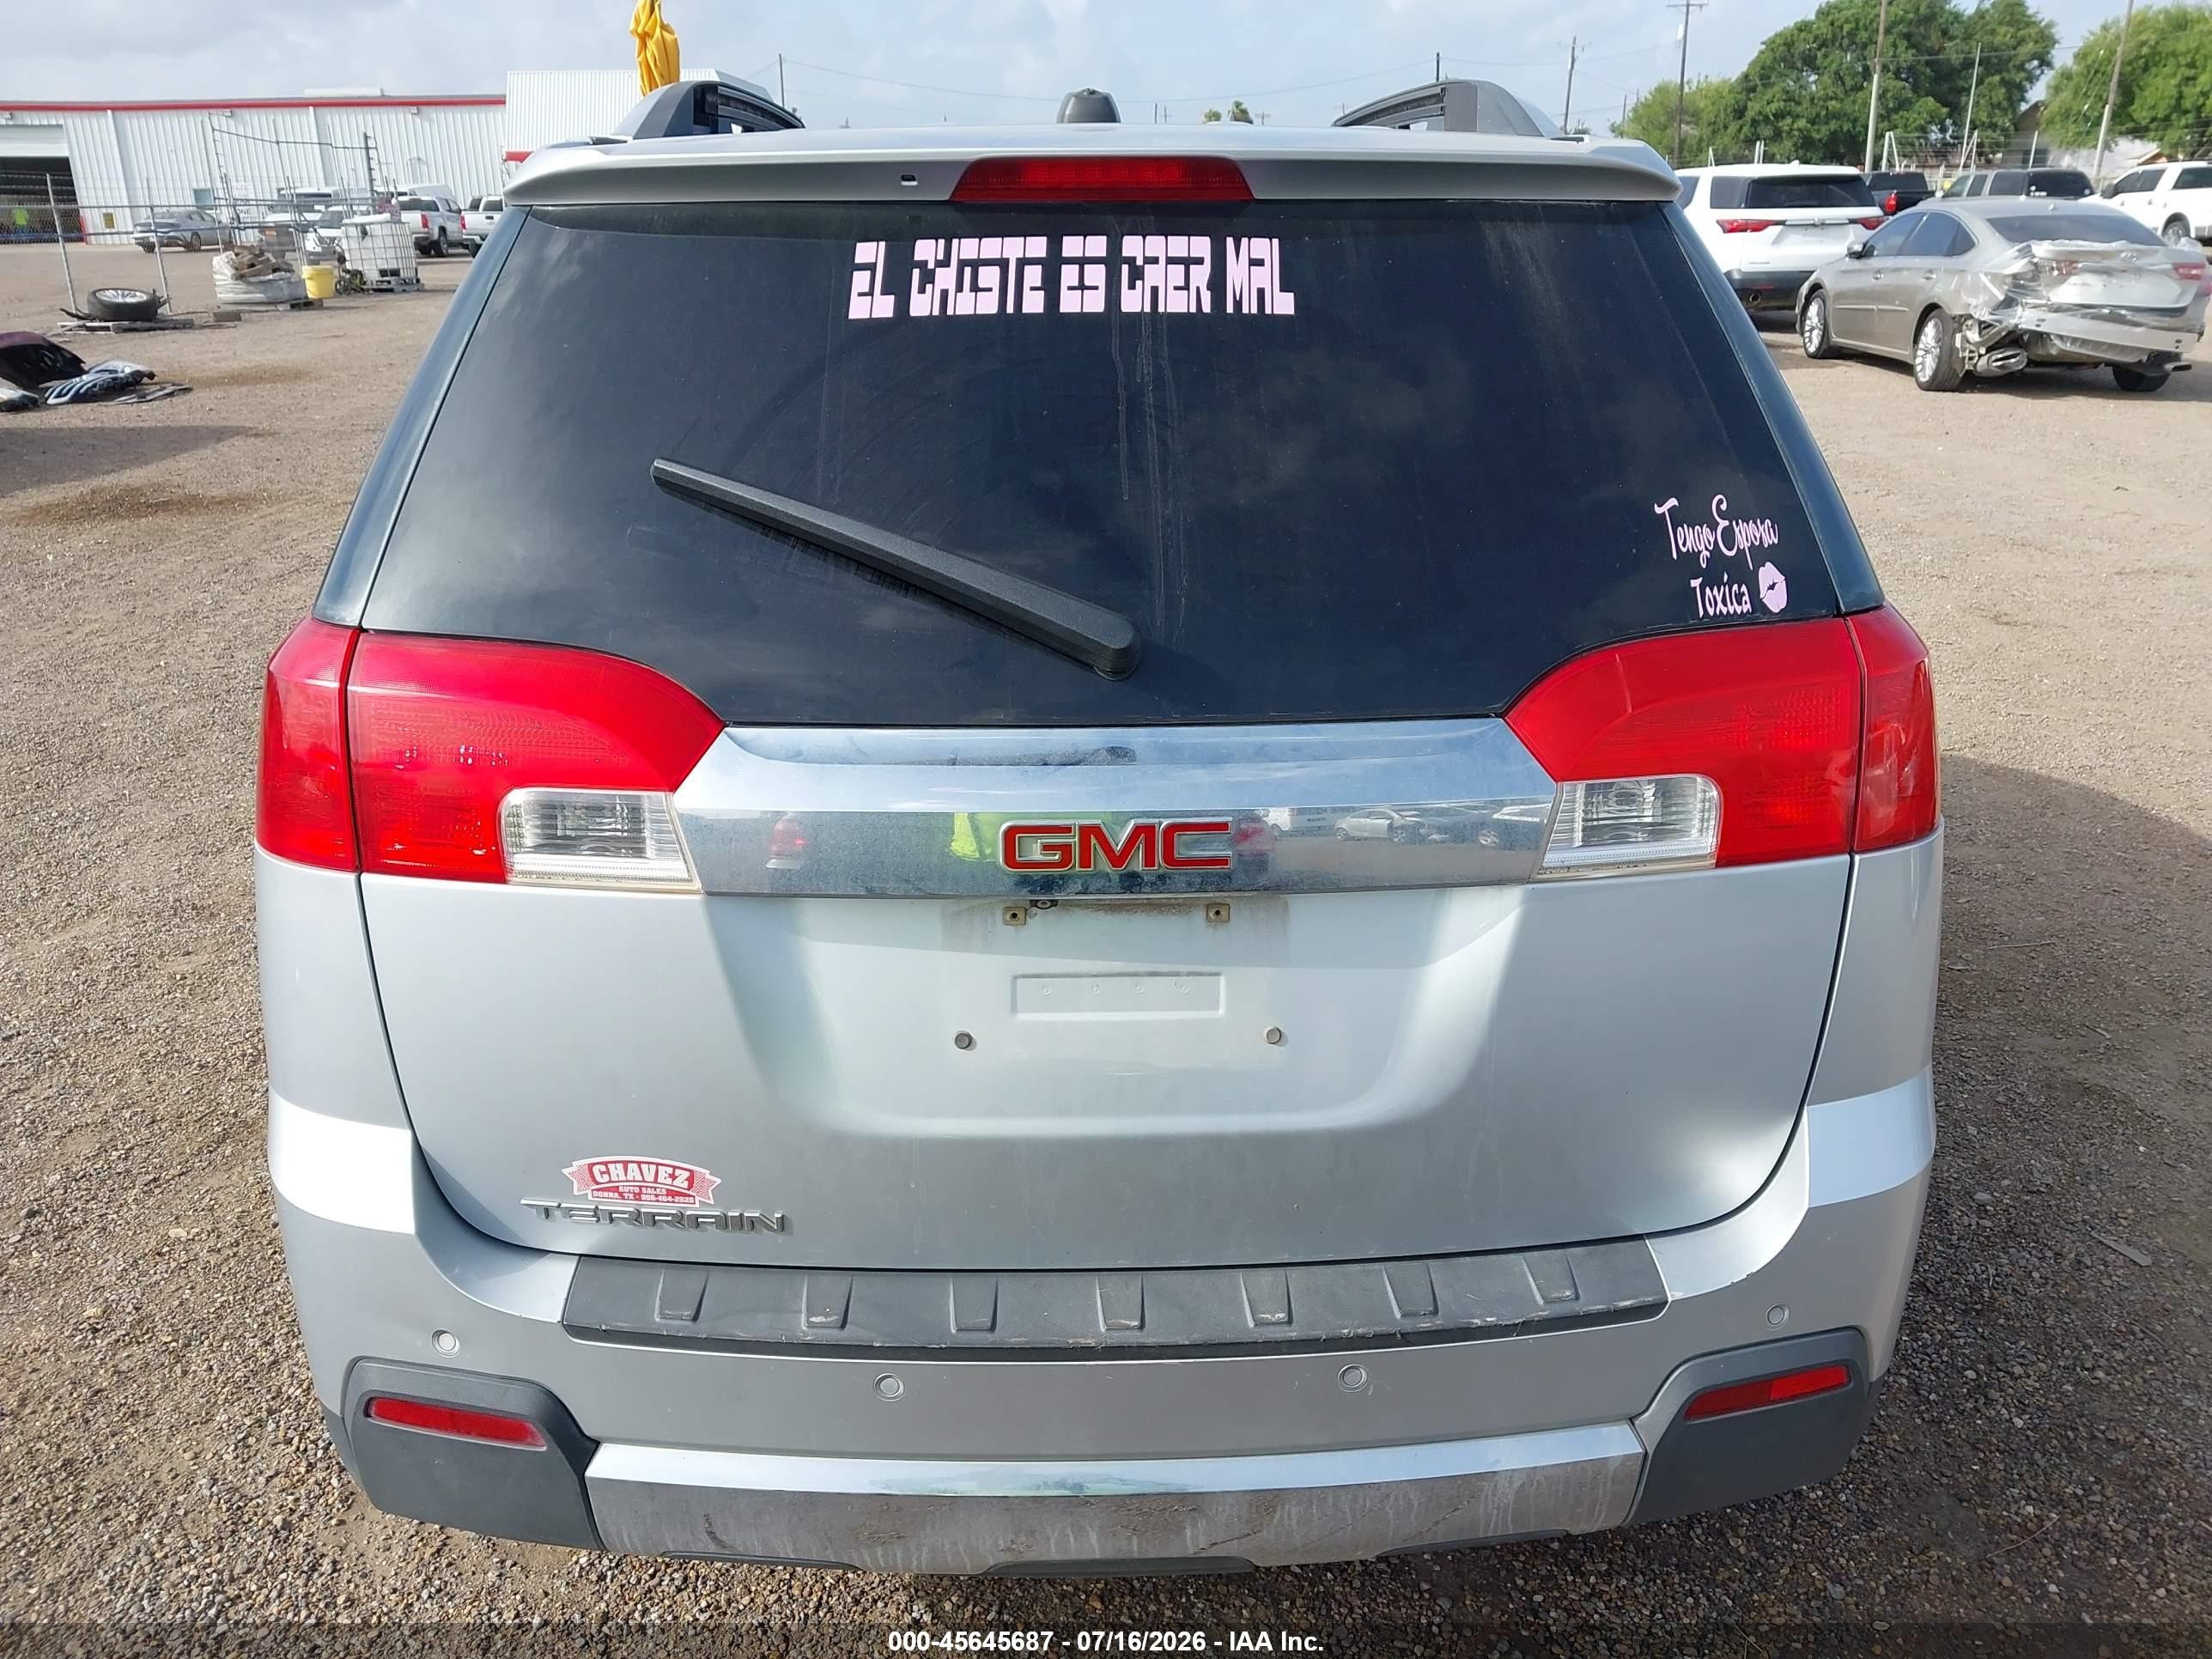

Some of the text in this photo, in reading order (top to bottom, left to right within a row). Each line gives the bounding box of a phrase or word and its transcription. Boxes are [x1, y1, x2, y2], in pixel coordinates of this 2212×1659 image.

[848, 234, 1296, 320] EL CHISTE ES CAER MAL
[1654, 494, 1779, 570] Tengo Esposa
[999, 817, 1233, 872] GMC
[592, 1163, 691, 1189] CHAVEZ
[520, 1196, 786, 1233] TERRAIN
